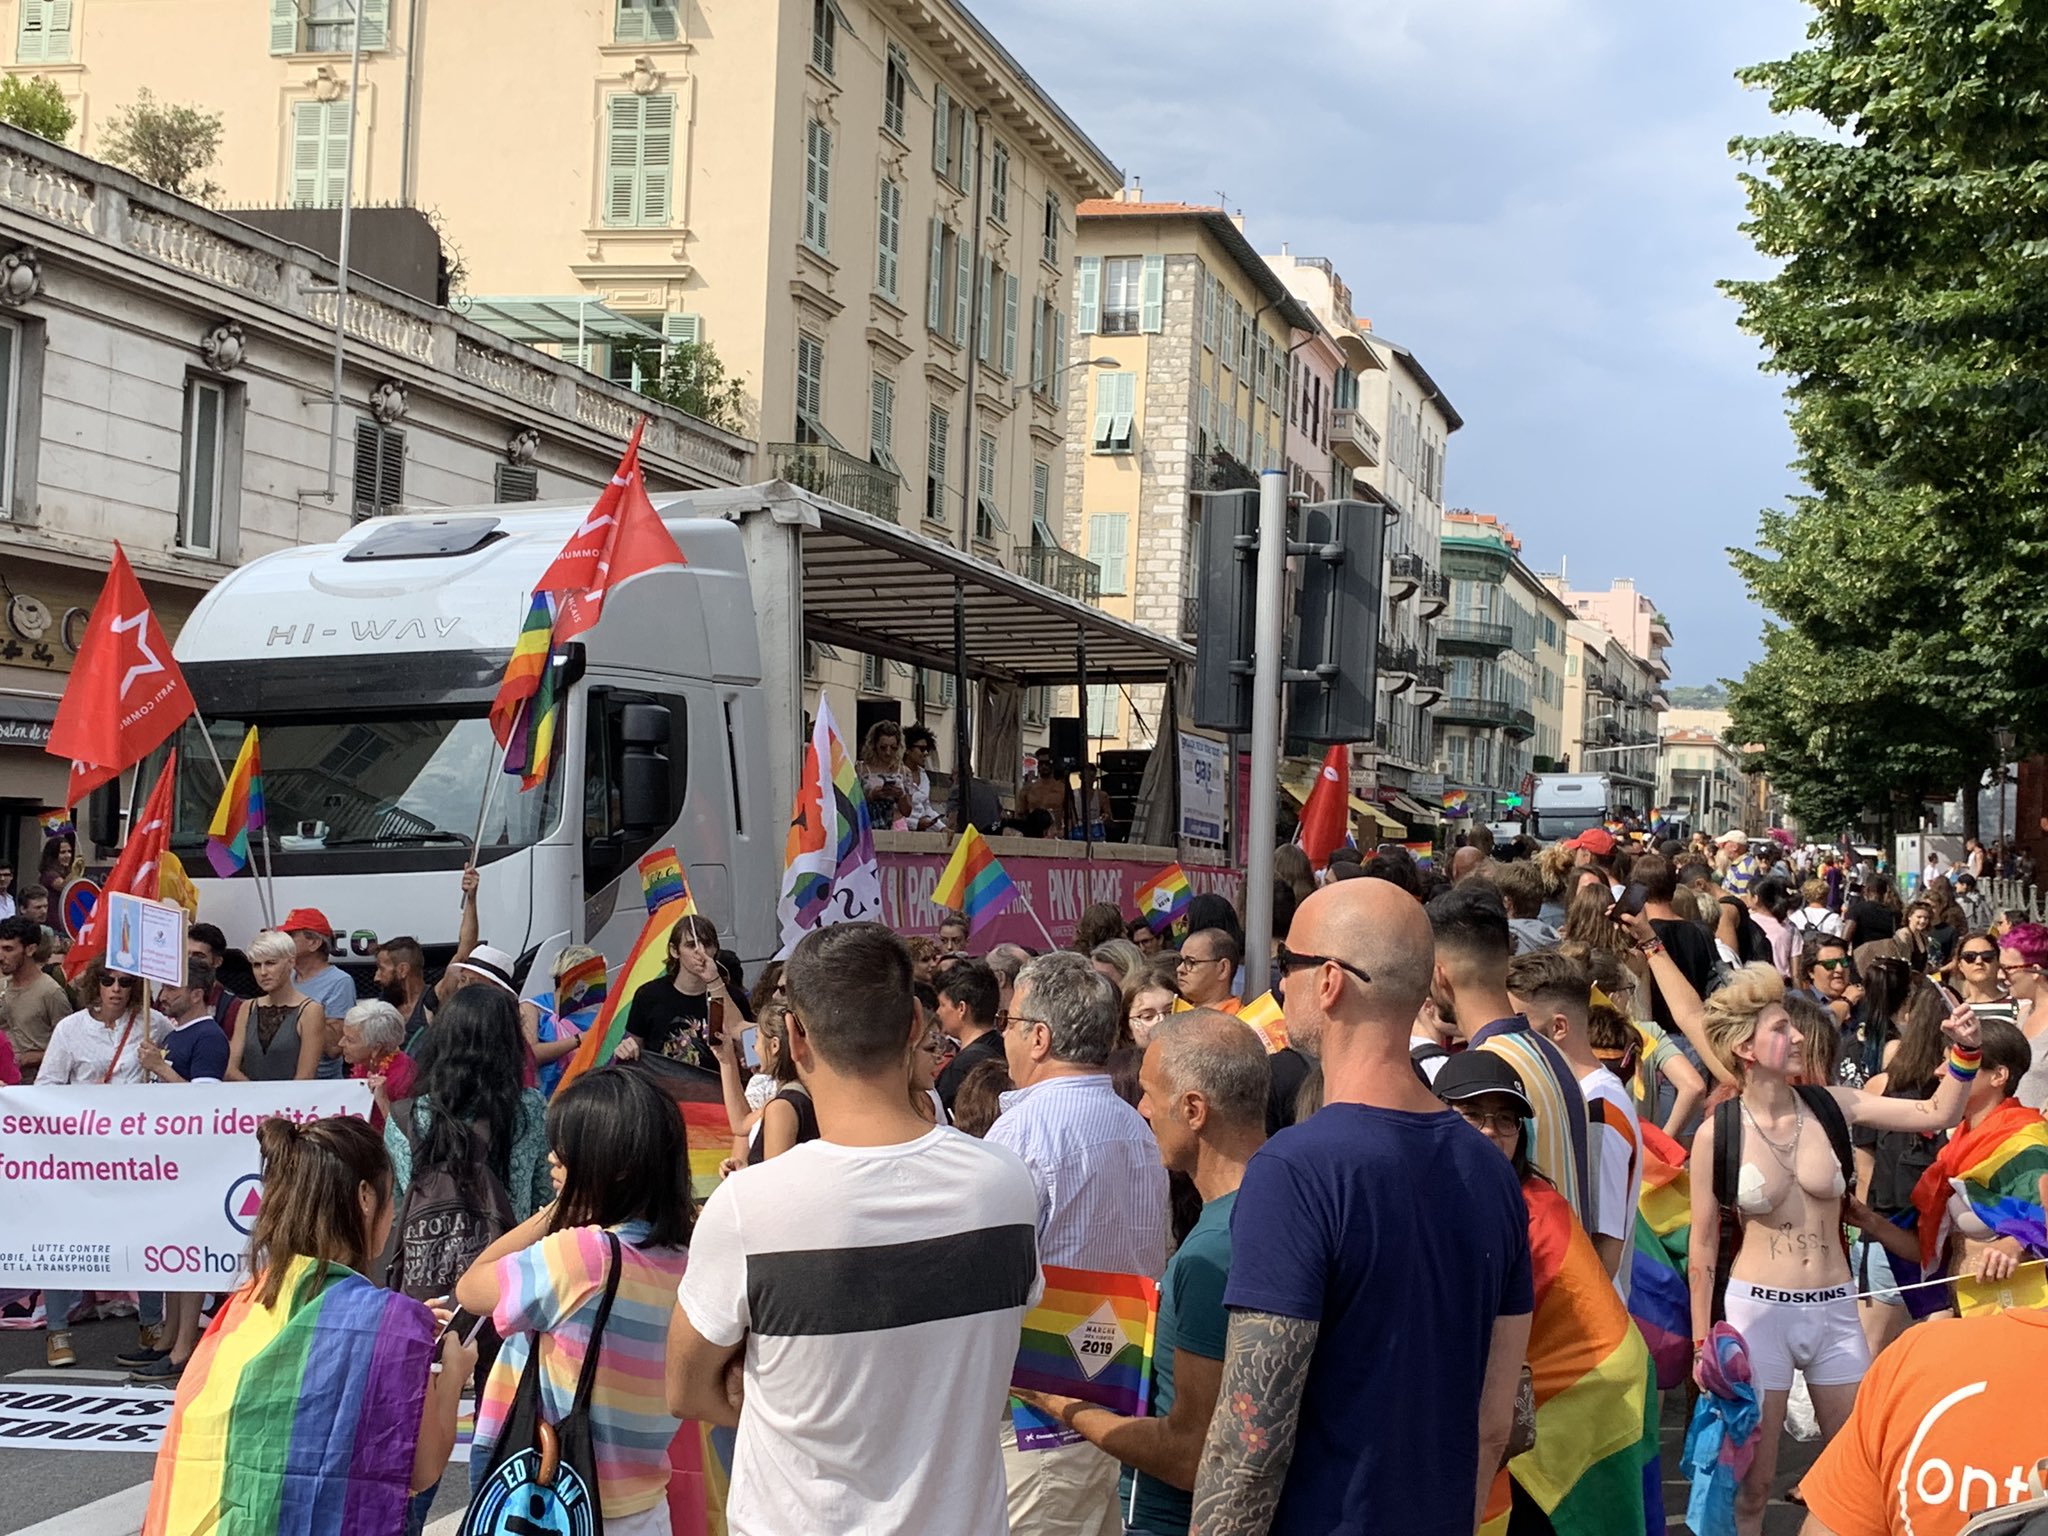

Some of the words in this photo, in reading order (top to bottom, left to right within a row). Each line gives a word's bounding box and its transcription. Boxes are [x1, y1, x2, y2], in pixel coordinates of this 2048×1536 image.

[2, 1109, 112, 1136] sexuelle
[120, 1112, 147, 1135] et
[154, 1115, 203, 1136] son
[31, 1244, 65, 1253] LUTTE
[69, 1244, 111, 1253] CONTRE
[0, 1253, 27, 1263] OBIE,
[32, 1254, 45, 1262] LA
[49, 1254, 110, 1263] GAYPHOBIE
[3, 1263, 15, 1271] ET
[19, 1263, 32, 1272] LA
[37, 1263, 111, 1273] TRANSPHOBIE
[1750, 1285, 1847, 1304] REDSKINS
[1080, 1340, 1113, 1355] 2019
